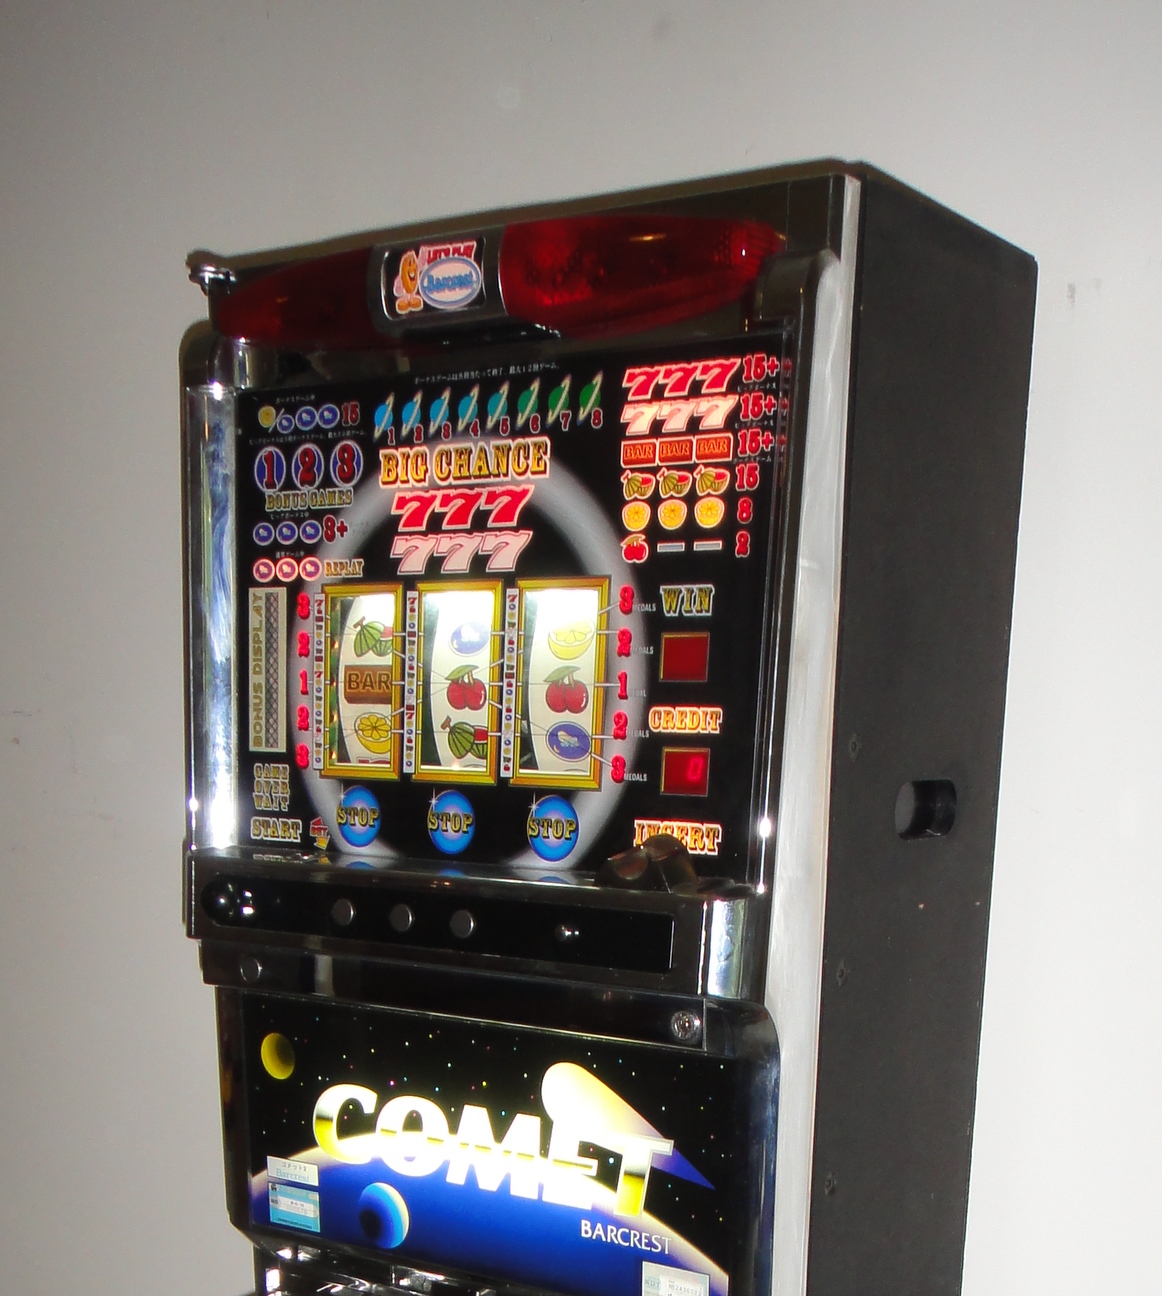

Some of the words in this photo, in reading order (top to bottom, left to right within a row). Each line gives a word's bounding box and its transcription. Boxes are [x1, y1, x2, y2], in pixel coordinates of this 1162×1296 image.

[342, 401, 360, 426] 15
[387, 426, 396, 445] 1
[470, 418, 480, 438] 4
[500, 416, 510, 436] 5
[530, 413, 541, 434] 6
[560, 410, 572, 431] 7
[591, 407, 603, 429] 8
[623, 443, 654, 460] BAR
[660, 441, 690, 458] BAR
[697, 438, 728, 455] BAR
[262, 449, 279, 491] 1
[298, 445, 318, 488] 2
[337, 442, 357, 485] 3
[379, 444, 430, 489] BIG
[433, 437, 550, 486] CHANCE
[735, 463, 759, 491] 15
[265, 491, 308, 512] BONUS
[309, 487, 353, 509] GAMES
[391, 485, 535, 532] 777
[737, 497, 753, 524] 8
[390, 531, 533, 575] 777
[735, 530, 750, 557] 2
[324, 559, 364, 578] REPLAY
[660, 584, 715, 617] WIN
[252, 592, 263, 675] DISPLAY
[617, 627, 632, 657] 2
[299, 670, 309, 695] 1
[347, 671, 392, 693] BAR
[618, 670, 628, 700] 1
[252, 682, 263, 747] BONUS
[613, 710, 628, 740] 2
[649, 707, 723, 734] CREDIT
[254, 763, 289, 780] GAME
[611, 754, 626, 783] 3
[254, 779, 290, 795] OVER
[253, 792, 290, 811] WAIT
[251, 816, 302, 843] START
[336, 806, 379, 828] STOP
[428, 809, 473, 834] STOP
[527, 815, 577, 841] STOP
[313, 1083, 673, 1217] COMET
[580, 1219, 672, 1254] BARCREST
